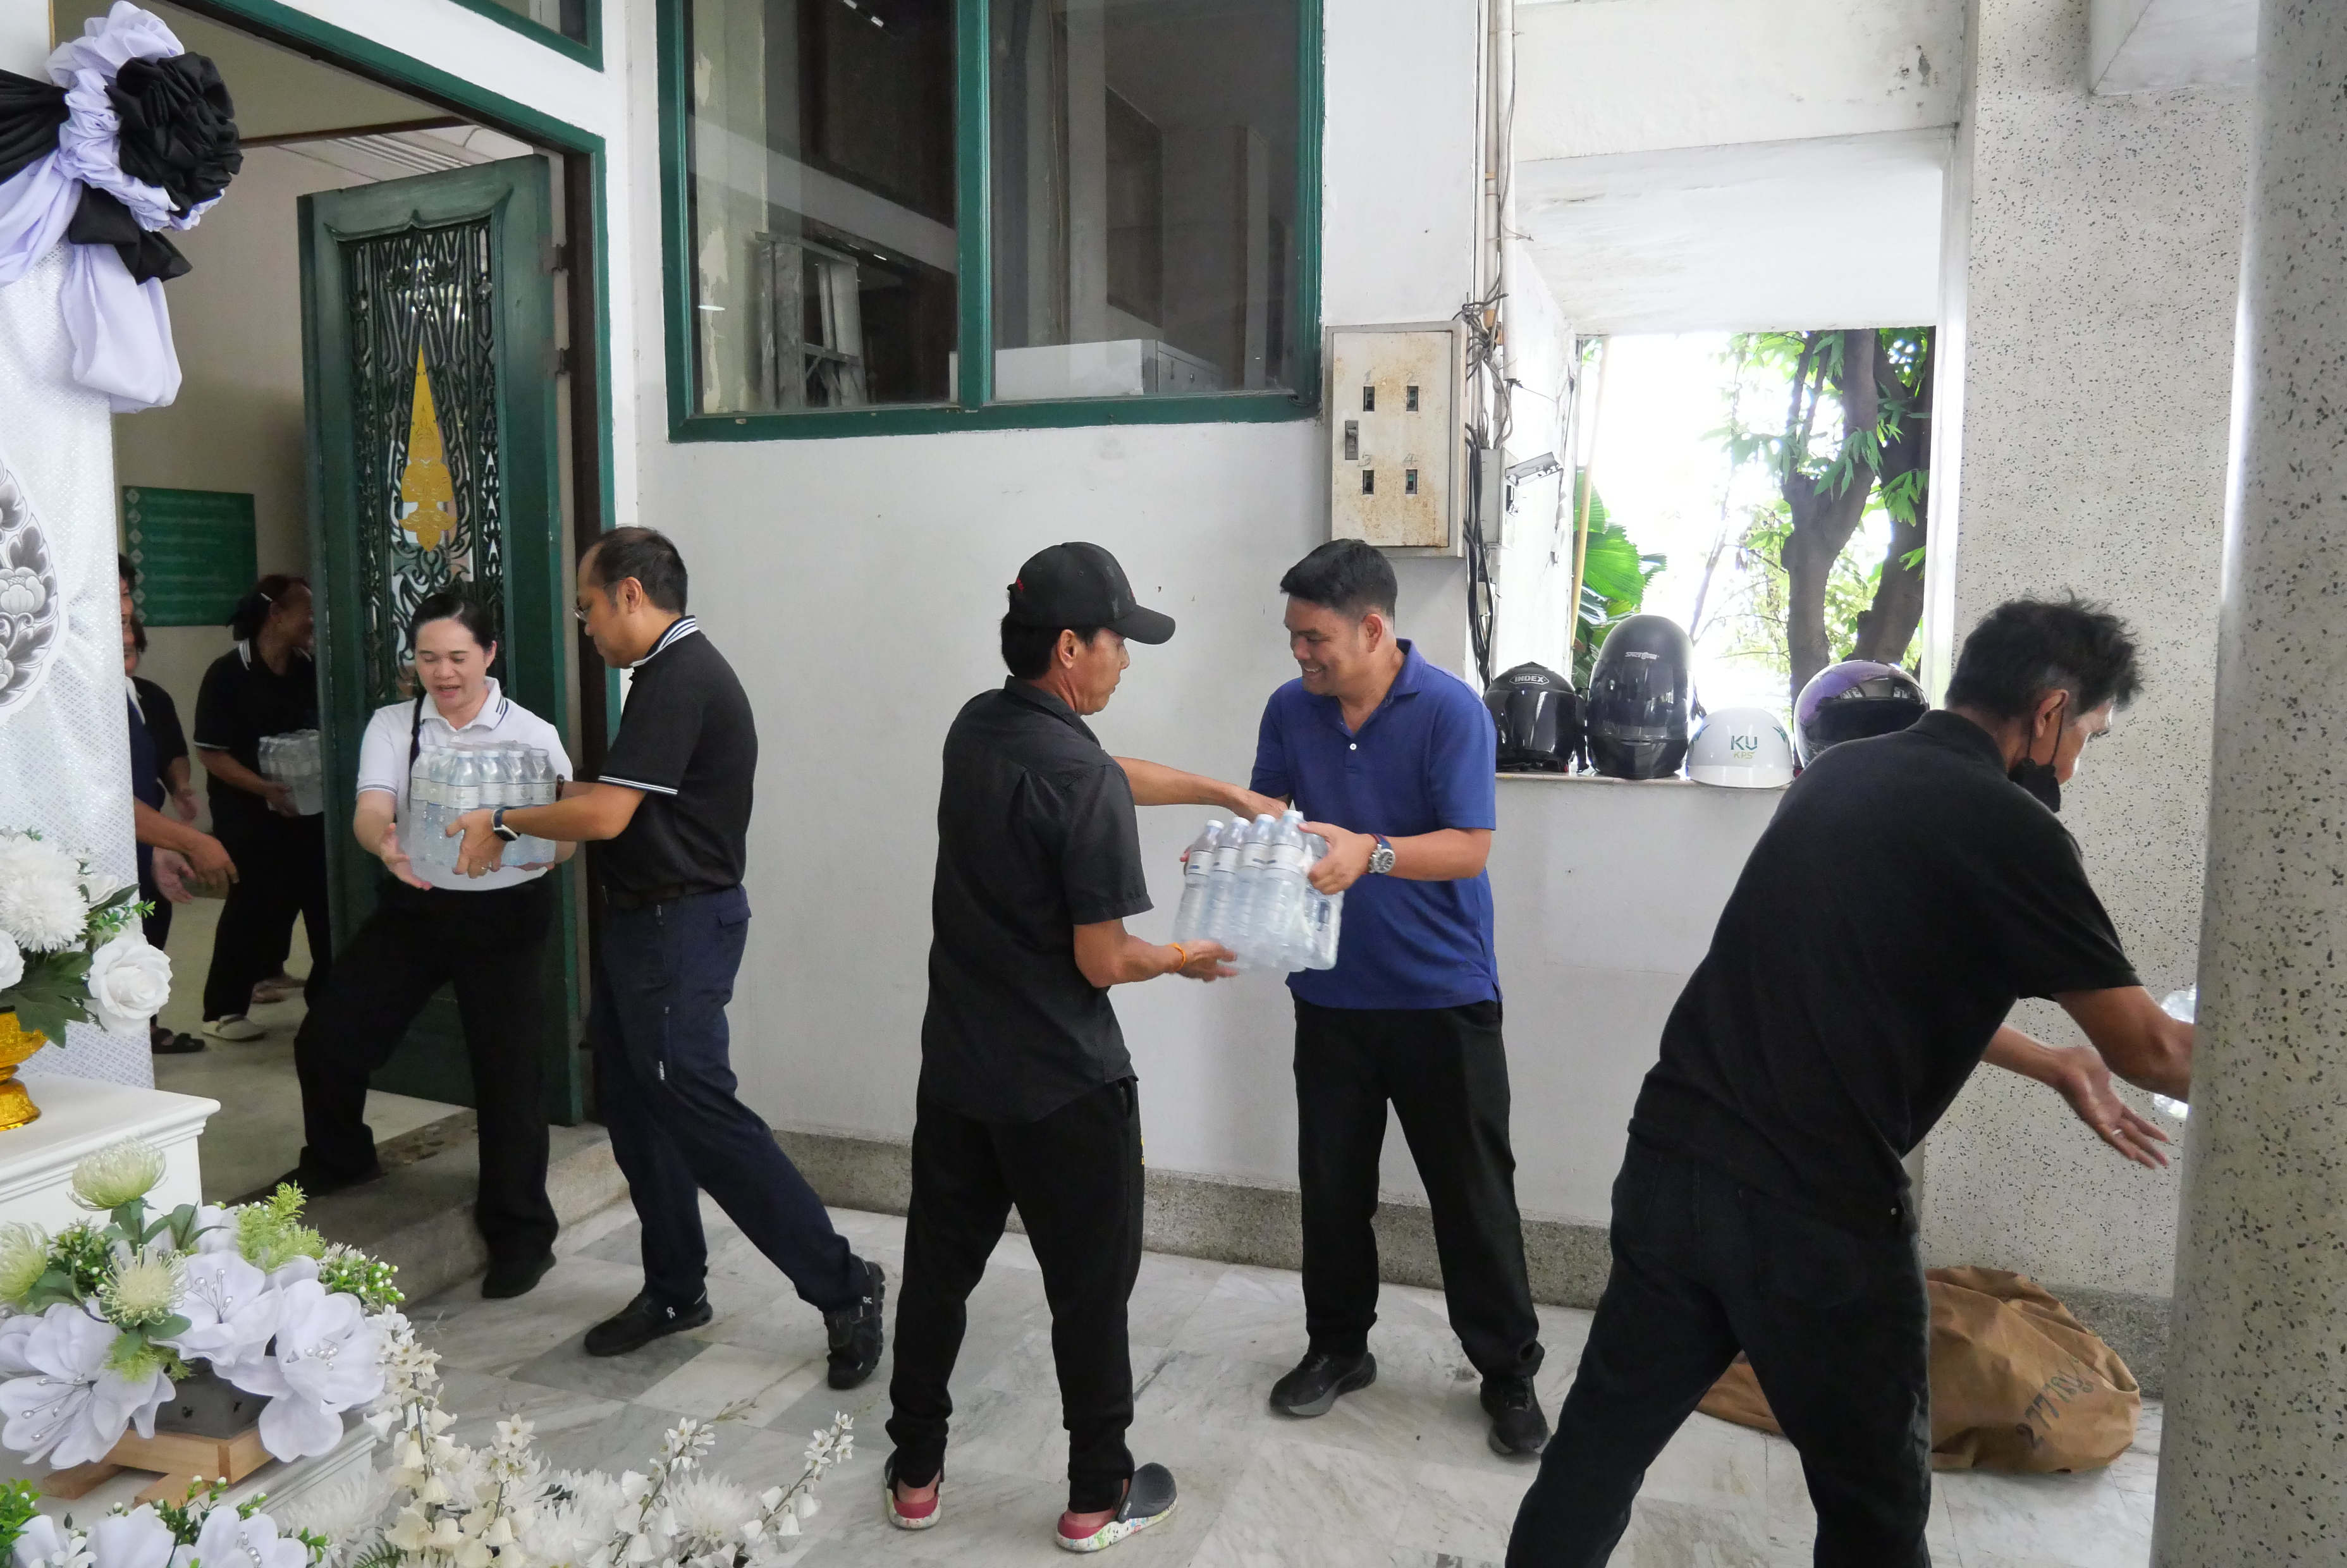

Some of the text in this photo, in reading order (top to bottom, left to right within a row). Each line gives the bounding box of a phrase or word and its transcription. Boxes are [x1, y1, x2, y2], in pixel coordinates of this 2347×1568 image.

[1363, 370, 1372, 385] 1
[1406, 371, 1417, 384] 2
[1402, 453, 1418, 465] 4
[1514, 675, 1544, 683] INDEX
[1731, 735, 1758, 750] KU
[1734, 751, 1756, 759] KPS
